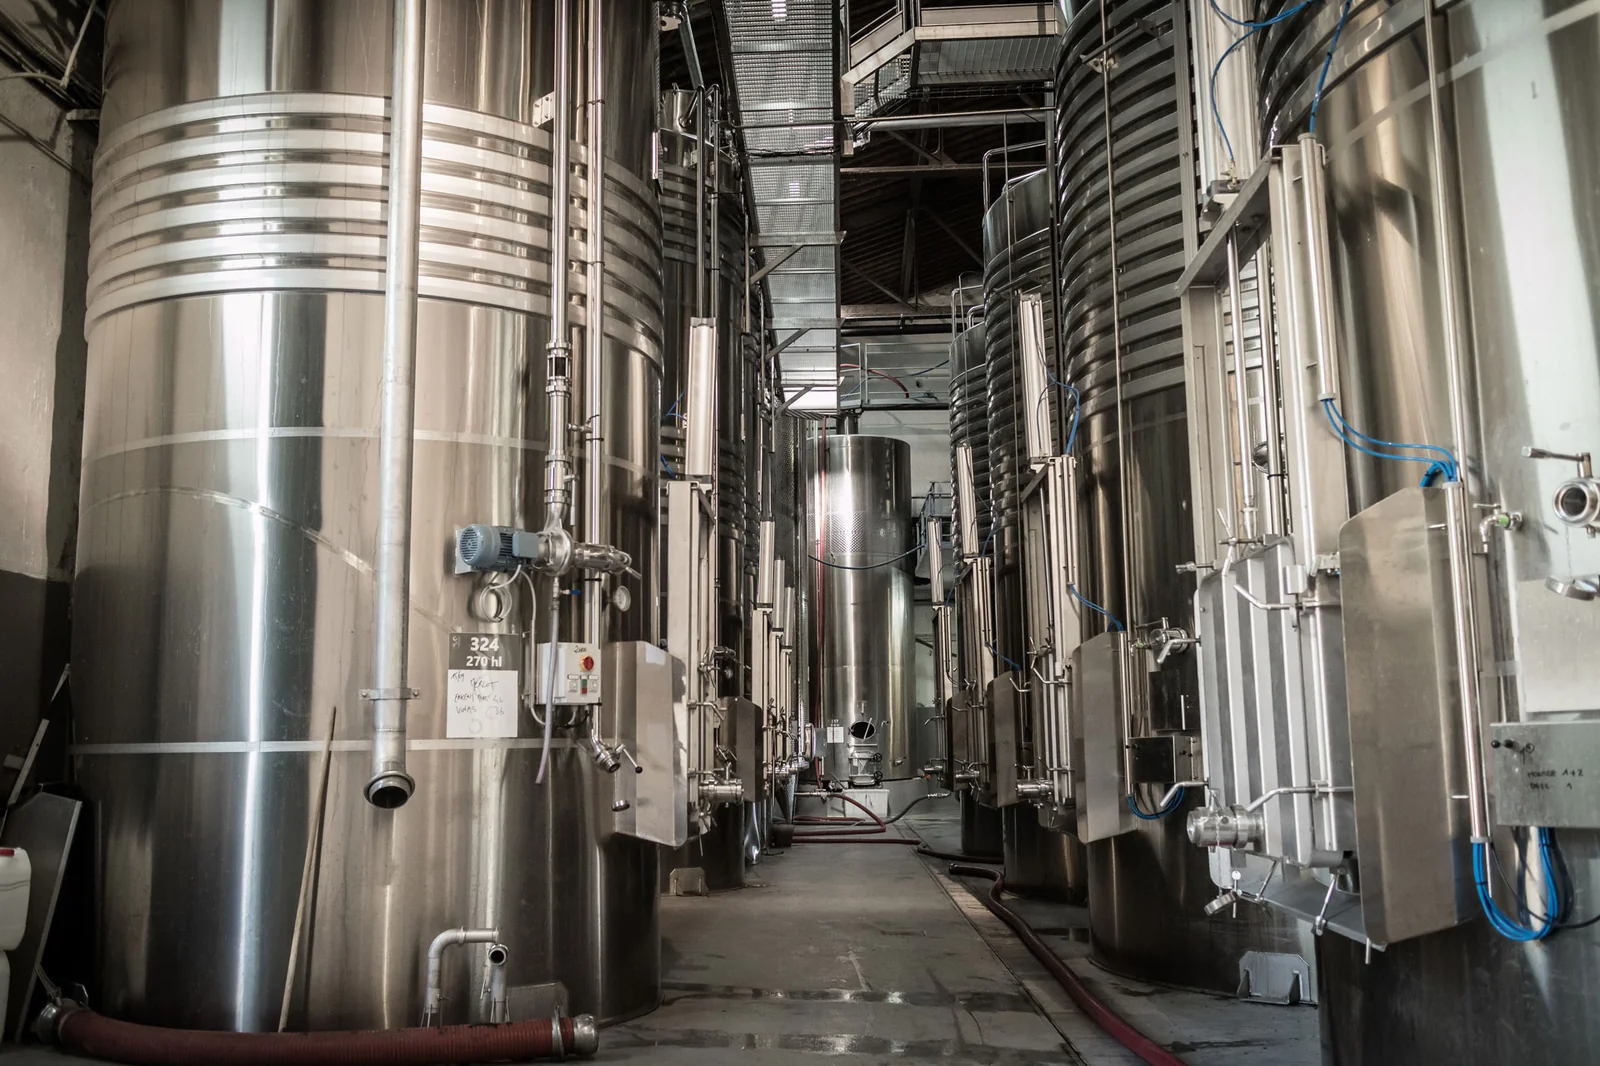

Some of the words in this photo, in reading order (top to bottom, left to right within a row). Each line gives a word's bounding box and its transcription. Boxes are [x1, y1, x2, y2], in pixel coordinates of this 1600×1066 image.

[470, 637, 499, 651] 324
[466, 656, 488, 667] 270
[491, 656, 502, 667] hl
